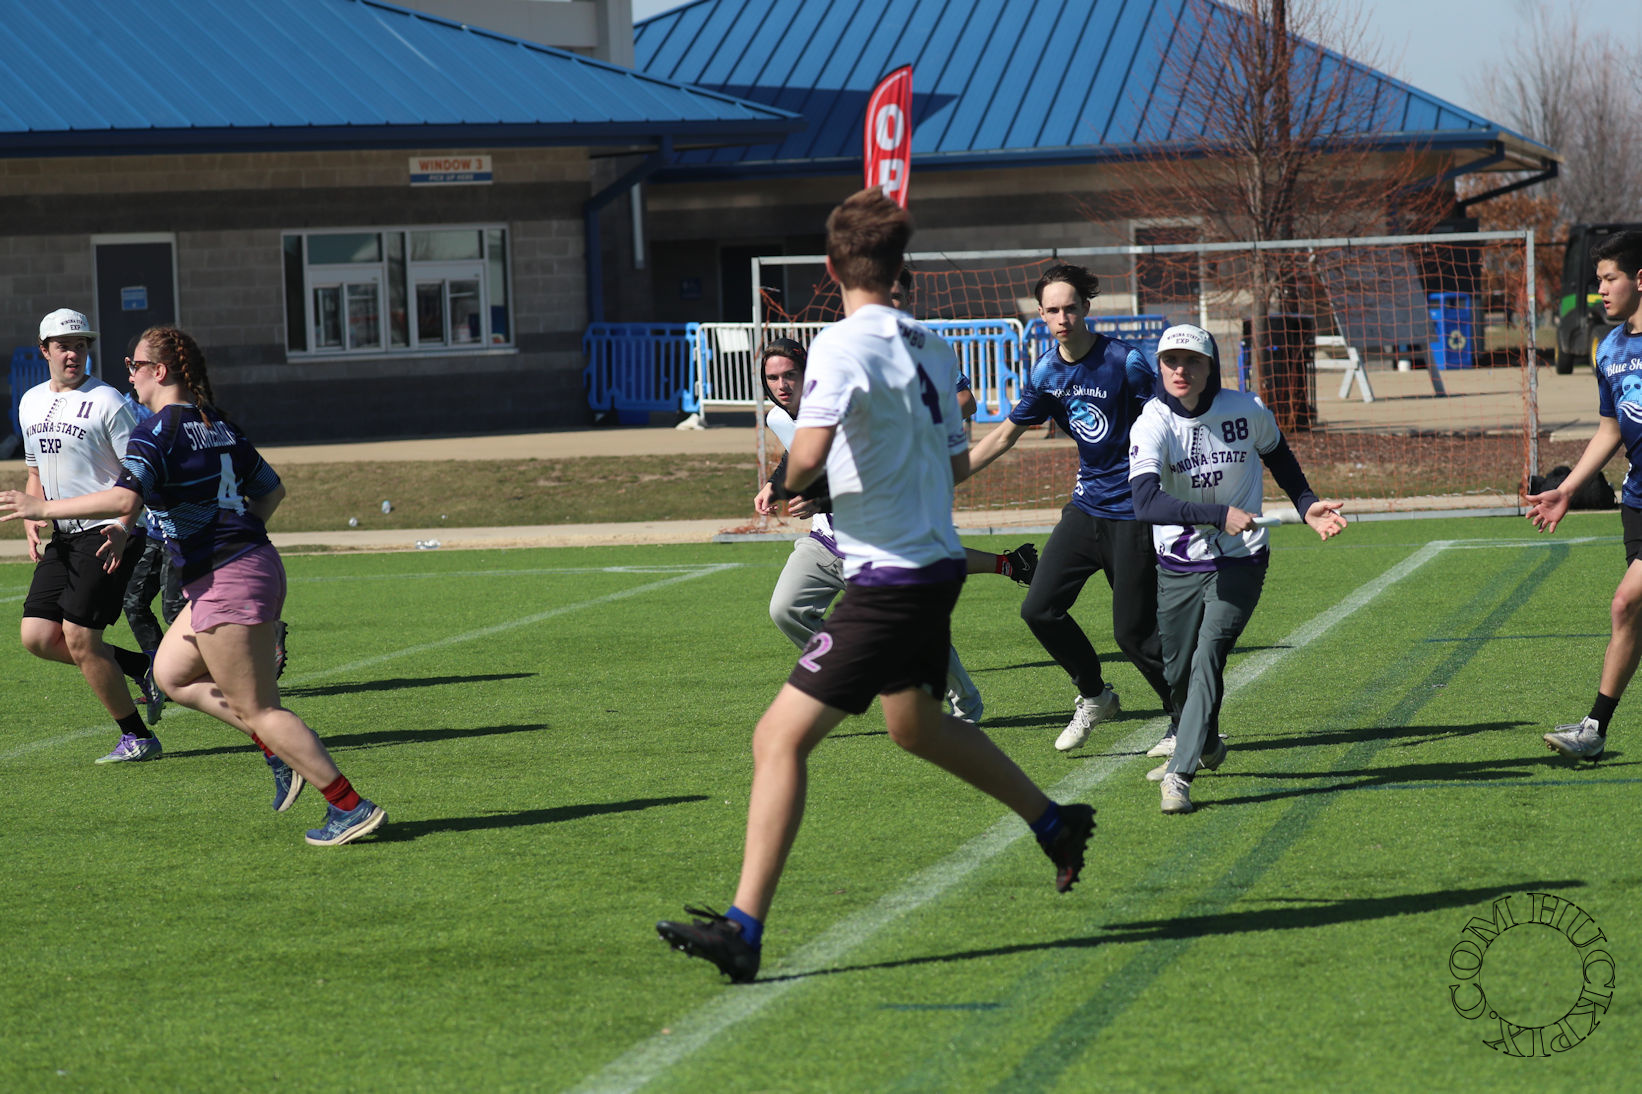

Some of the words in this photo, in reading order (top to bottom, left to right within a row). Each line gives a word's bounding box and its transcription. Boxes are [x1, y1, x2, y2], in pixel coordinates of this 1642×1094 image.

[418, 159, 472, 172] WINDOW
[476, 157, 483, 171] 3
[1167, 332, 1185, 340] WINONA
[1186, 333, 1200, 342] STATE
[1606, 362, 1627, 377] Blue
[1073, 384, 1107, 399] Skunks
[76, 401, 94, 419] 11
[55, 421, 87, 441] STATE
[1221, 417, 1249, 444] 88
[39, 438, 62, 454] EXP
[1211, 450, 1248, 464] STATE
[217, 452, 247, 517] 4
[1191, 470, 1224, 489] EXP
